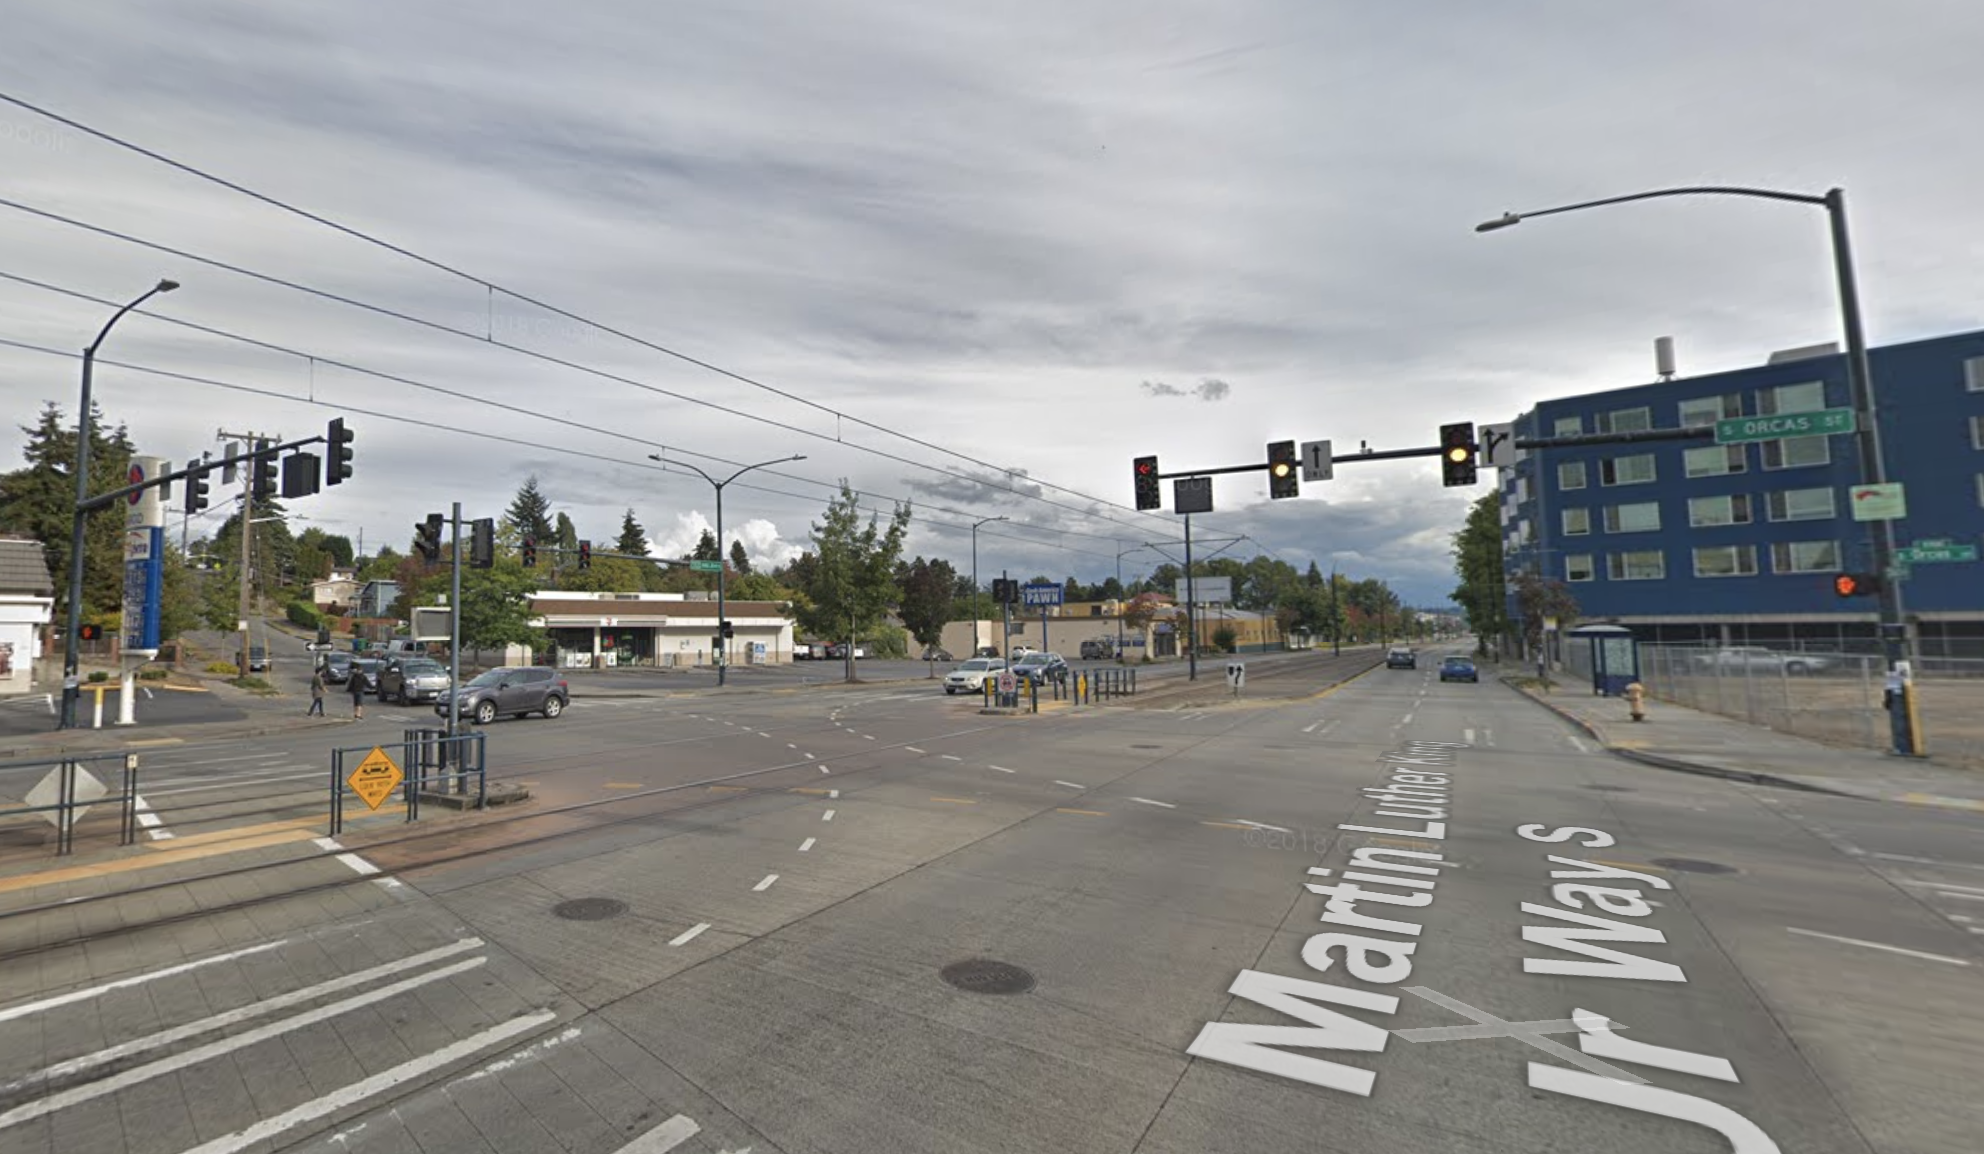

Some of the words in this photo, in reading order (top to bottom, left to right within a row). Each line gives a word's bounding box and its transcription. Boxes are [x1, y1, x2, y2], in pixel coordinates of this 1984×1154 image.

[1743, 416, 1811, 435] ORCAS
[1306, 470, 1331, 479] ONLY
[1026, 592, 1060, 604] PAWN
